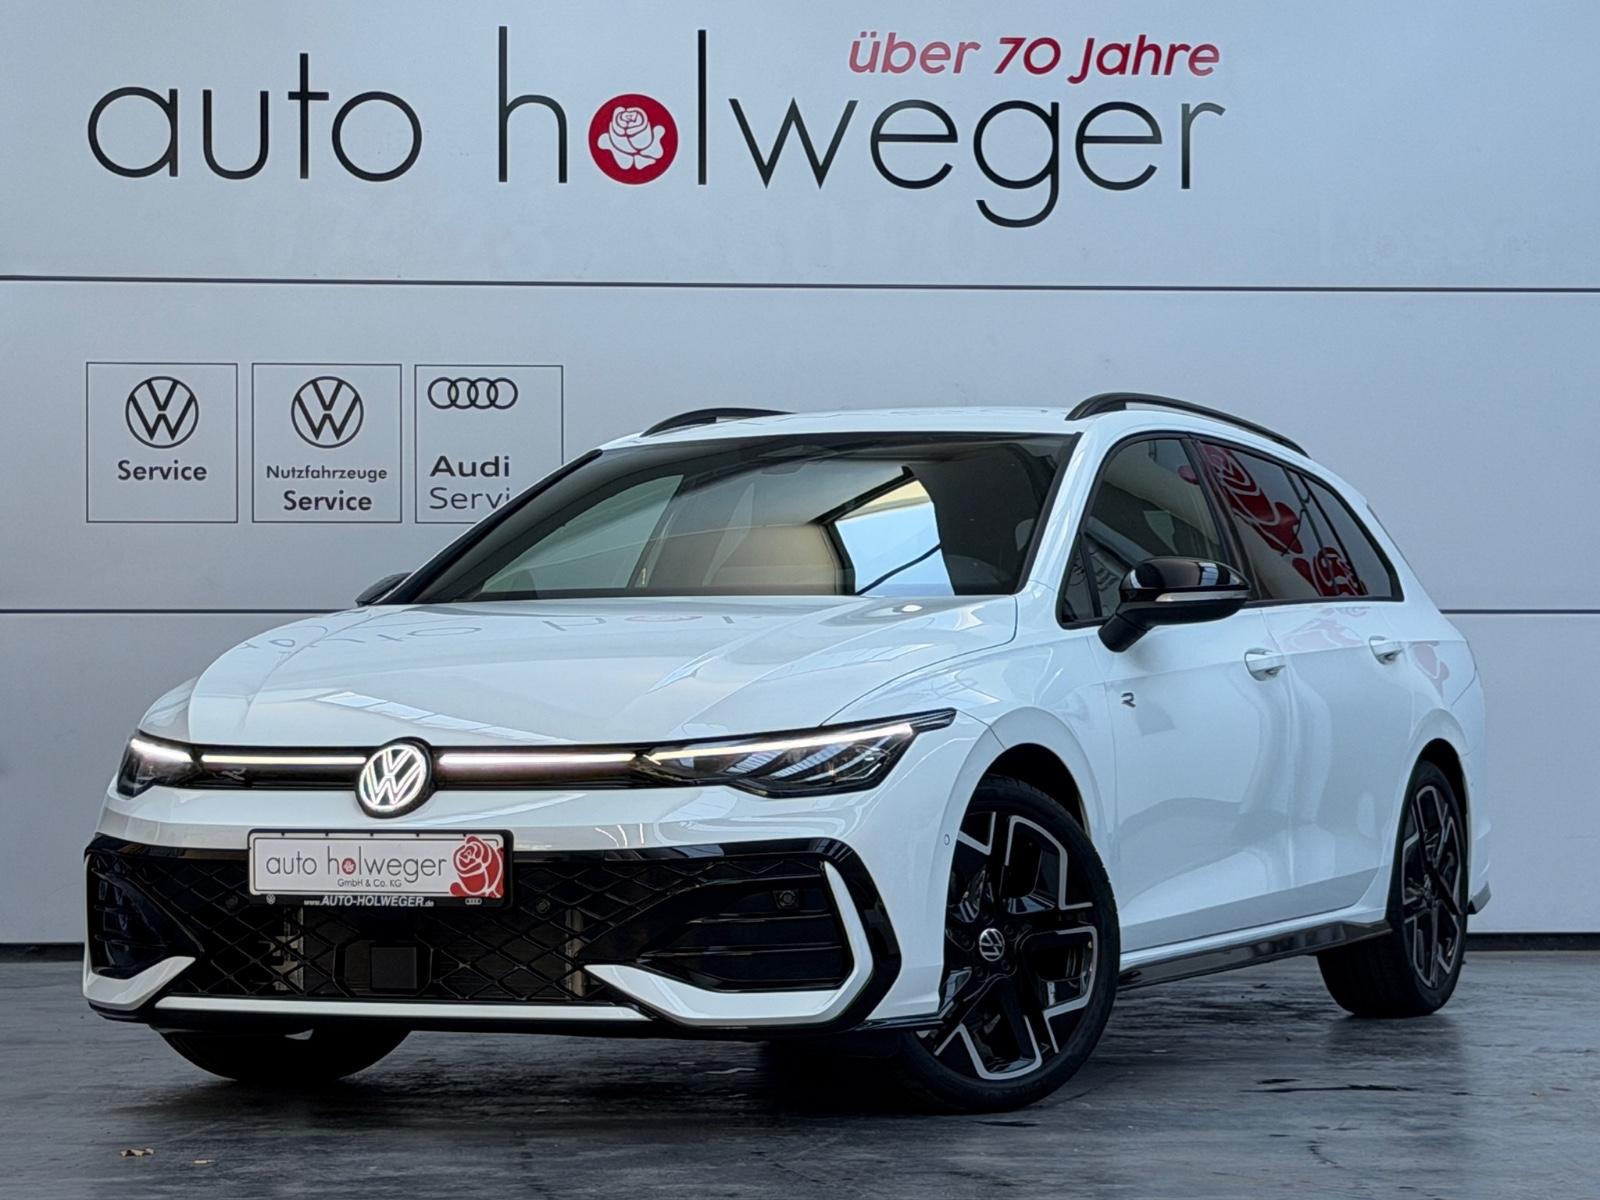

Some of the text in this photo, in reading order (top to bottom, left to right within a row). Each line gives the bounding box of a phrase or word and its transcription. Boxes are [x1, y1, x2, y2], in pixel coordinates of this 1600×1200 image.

[848, 31, 1220, 85] über 70 Jahre
[87, 52, 423, 182] auto
[117, 459, 208, 481] Service
[266, 464, 388, 483] Nutzfahrzeuge
[429, 455, 510, 478] Audi
[283, 489, 372, 511] Service
[429, 486, 511, 510] Servi
[266, 851, 318, 876] auto
[337, 878, 363, 888] GmbH
[364, 878, 372, 888] &
[389, 878, 402, 888] KG
